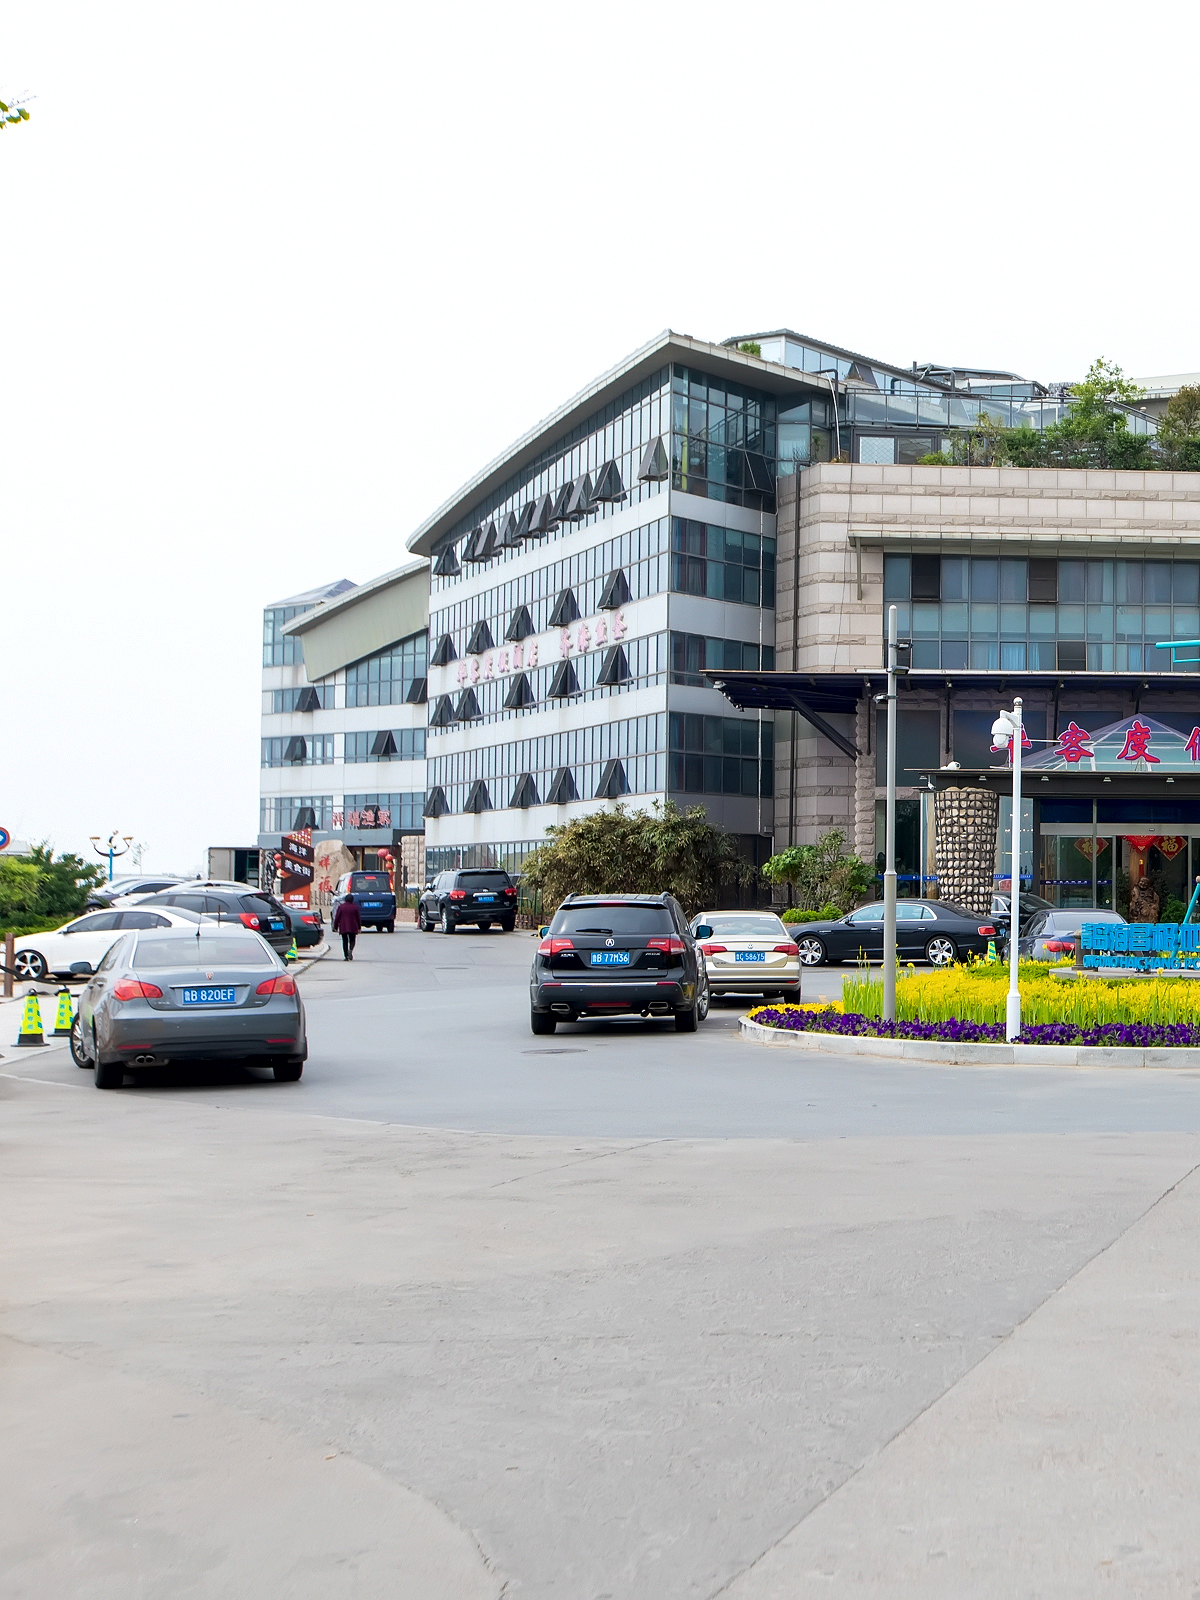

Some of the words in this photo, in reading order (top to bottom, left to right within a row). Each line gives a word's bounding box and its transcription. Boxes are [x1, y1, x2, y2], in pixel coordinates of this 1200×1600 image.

[289, 842, 308, 856] 海洋
[284, 859, 311, 877] 美食街
[1120, 956, 1181, 970] HAICHANG
